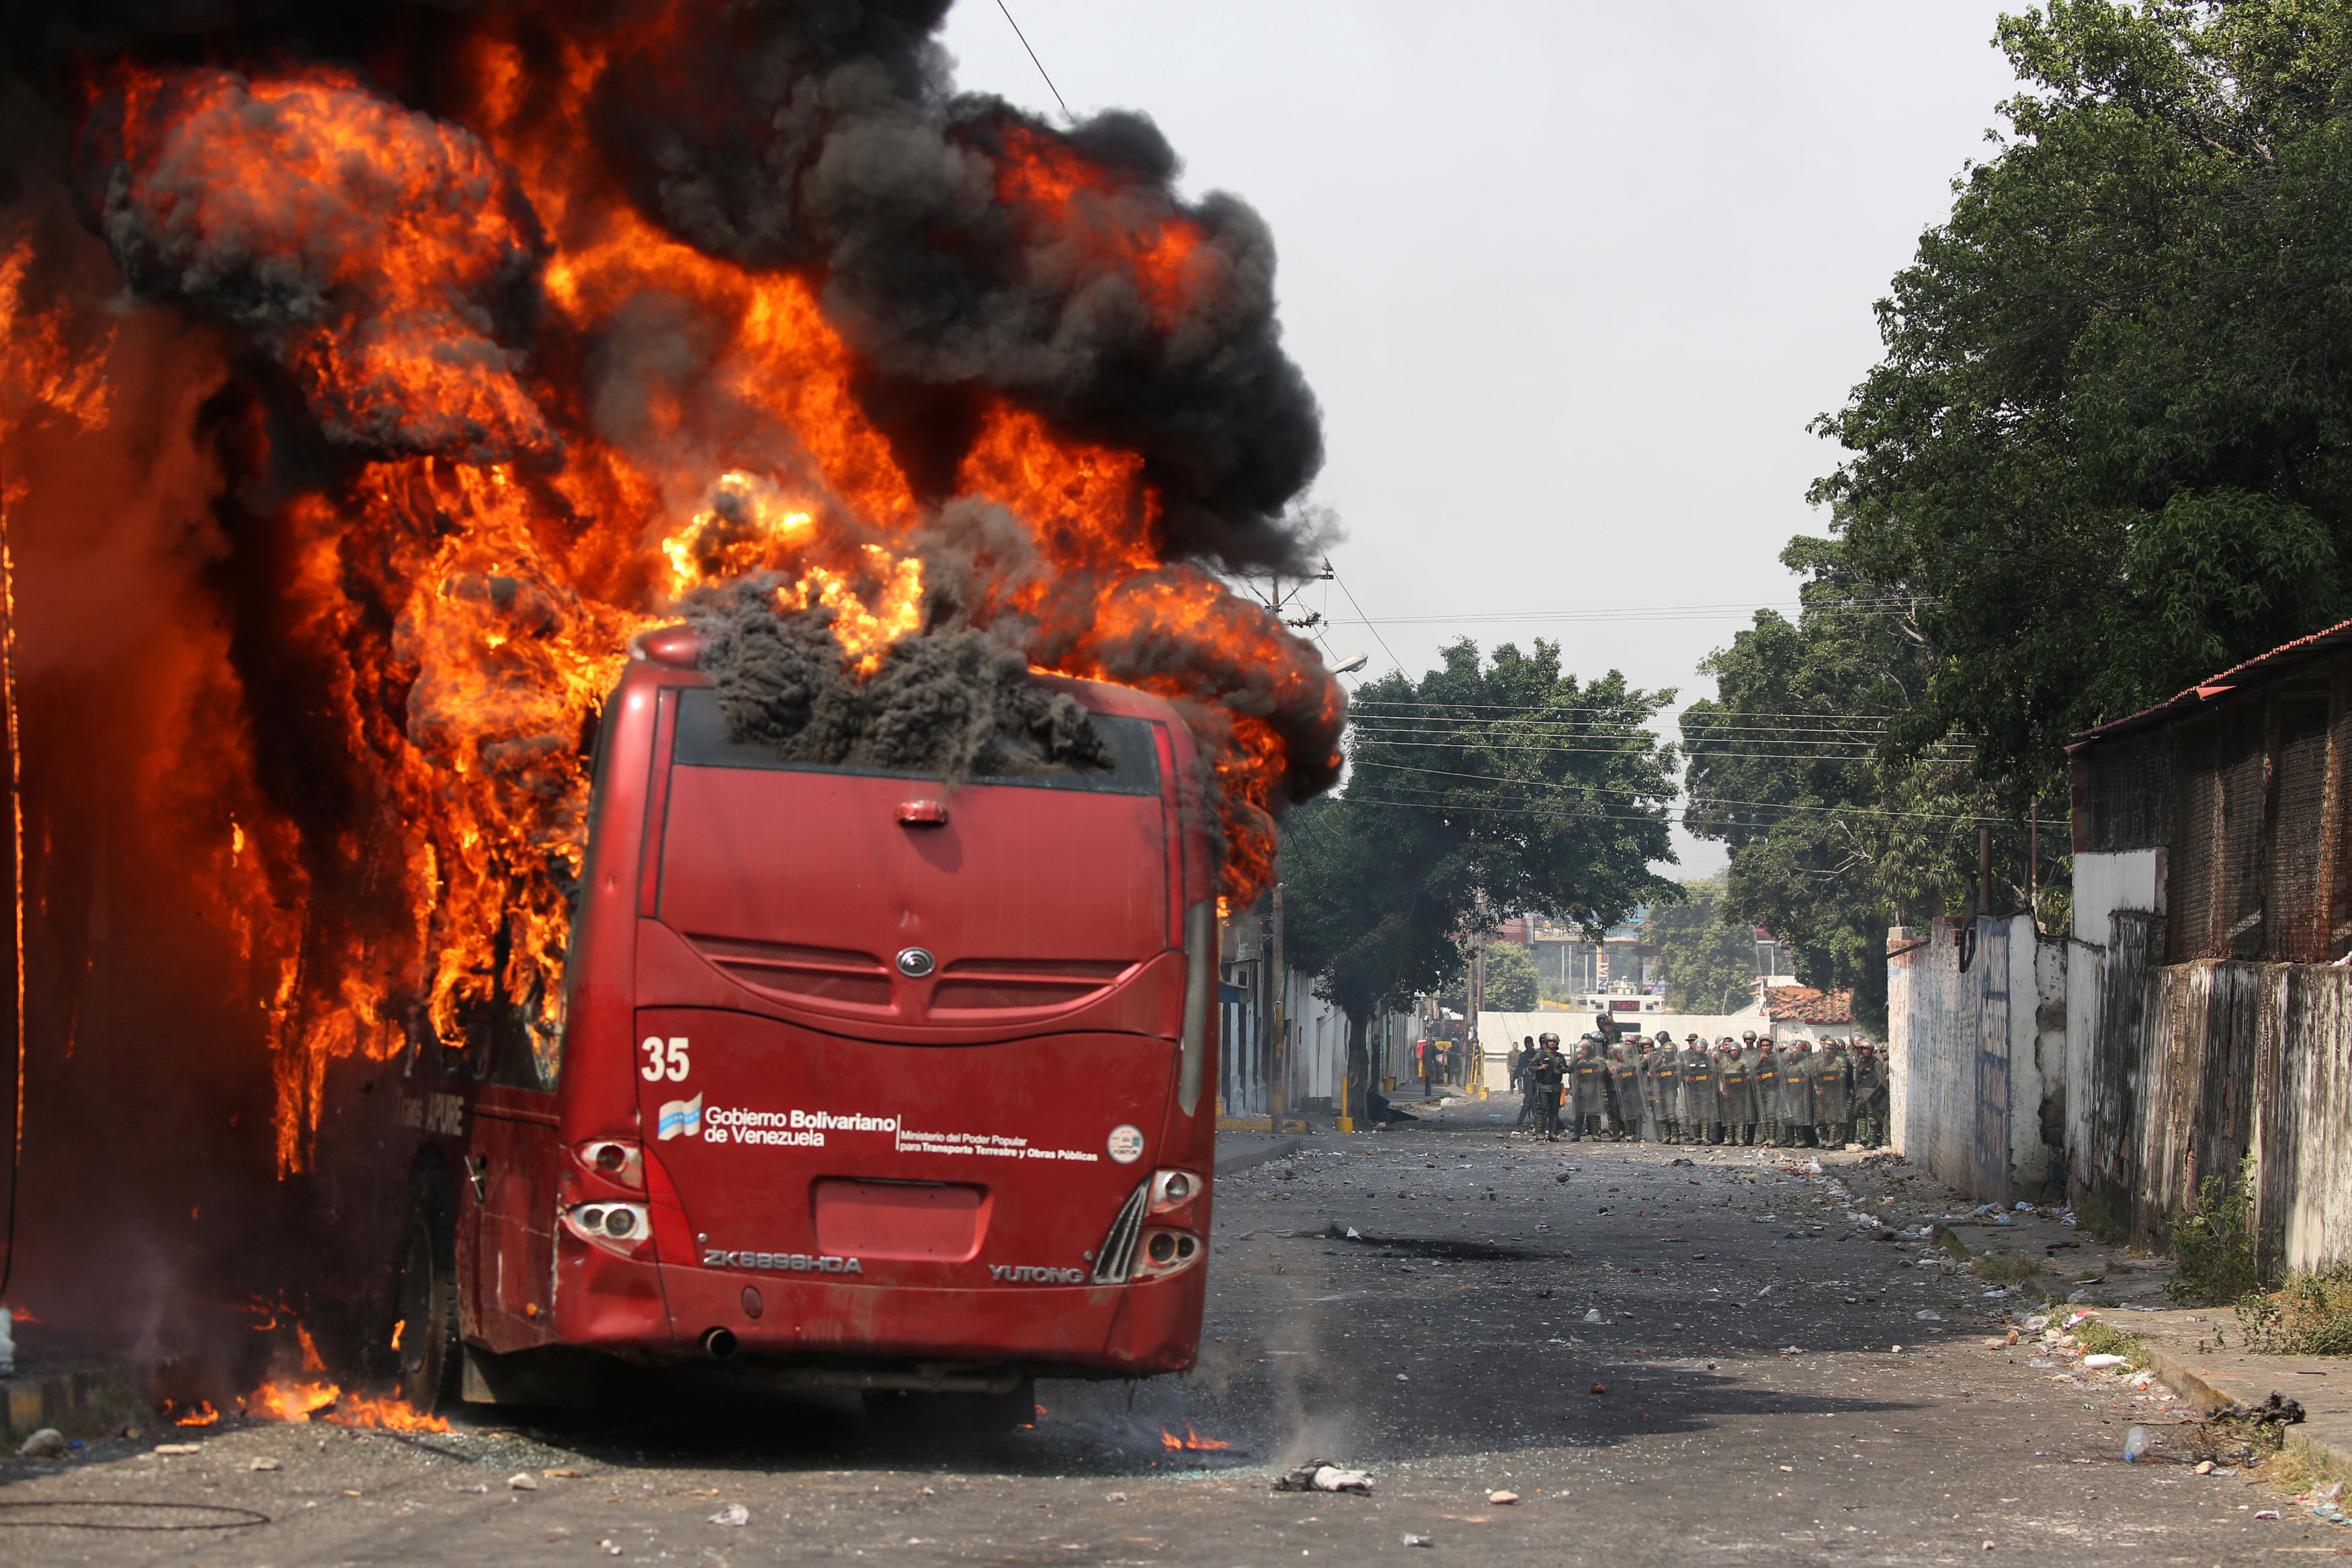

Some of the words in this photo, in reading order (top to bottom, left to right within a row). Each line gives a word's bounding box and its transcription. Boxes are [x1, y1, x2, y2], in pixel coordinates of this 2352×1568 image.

[641, 1037, 690, 1082] 35
[425, 1092, 464, 1137] APURE
[705, 1106, 787, 1128] Gobierno
[790, 1109, 896, 1132] Bolivariano
[704, 1124, 728, 1143] de
[731, 1125, 825, 1147] Venezuela
[900, 1129, 946, 1142] Ministerio
[946, 1132, 962, 1143] del
[962, 1133, 991, 1144] Poder
[991, 1135, 1027, 1147] Popular
[899, 1142, 922, 1153] para
[921, 1141, 974, 1155] Transporte
[974, 1145, 1017, 1157] Terrestre
[1019, 1149, 1025, 1159] y
[1027, 1147, 1056, 1159] Obras
[1057, 1149, 1098, 1162] Públicas
[989, 1264, 1085, 1284] YUTONG
